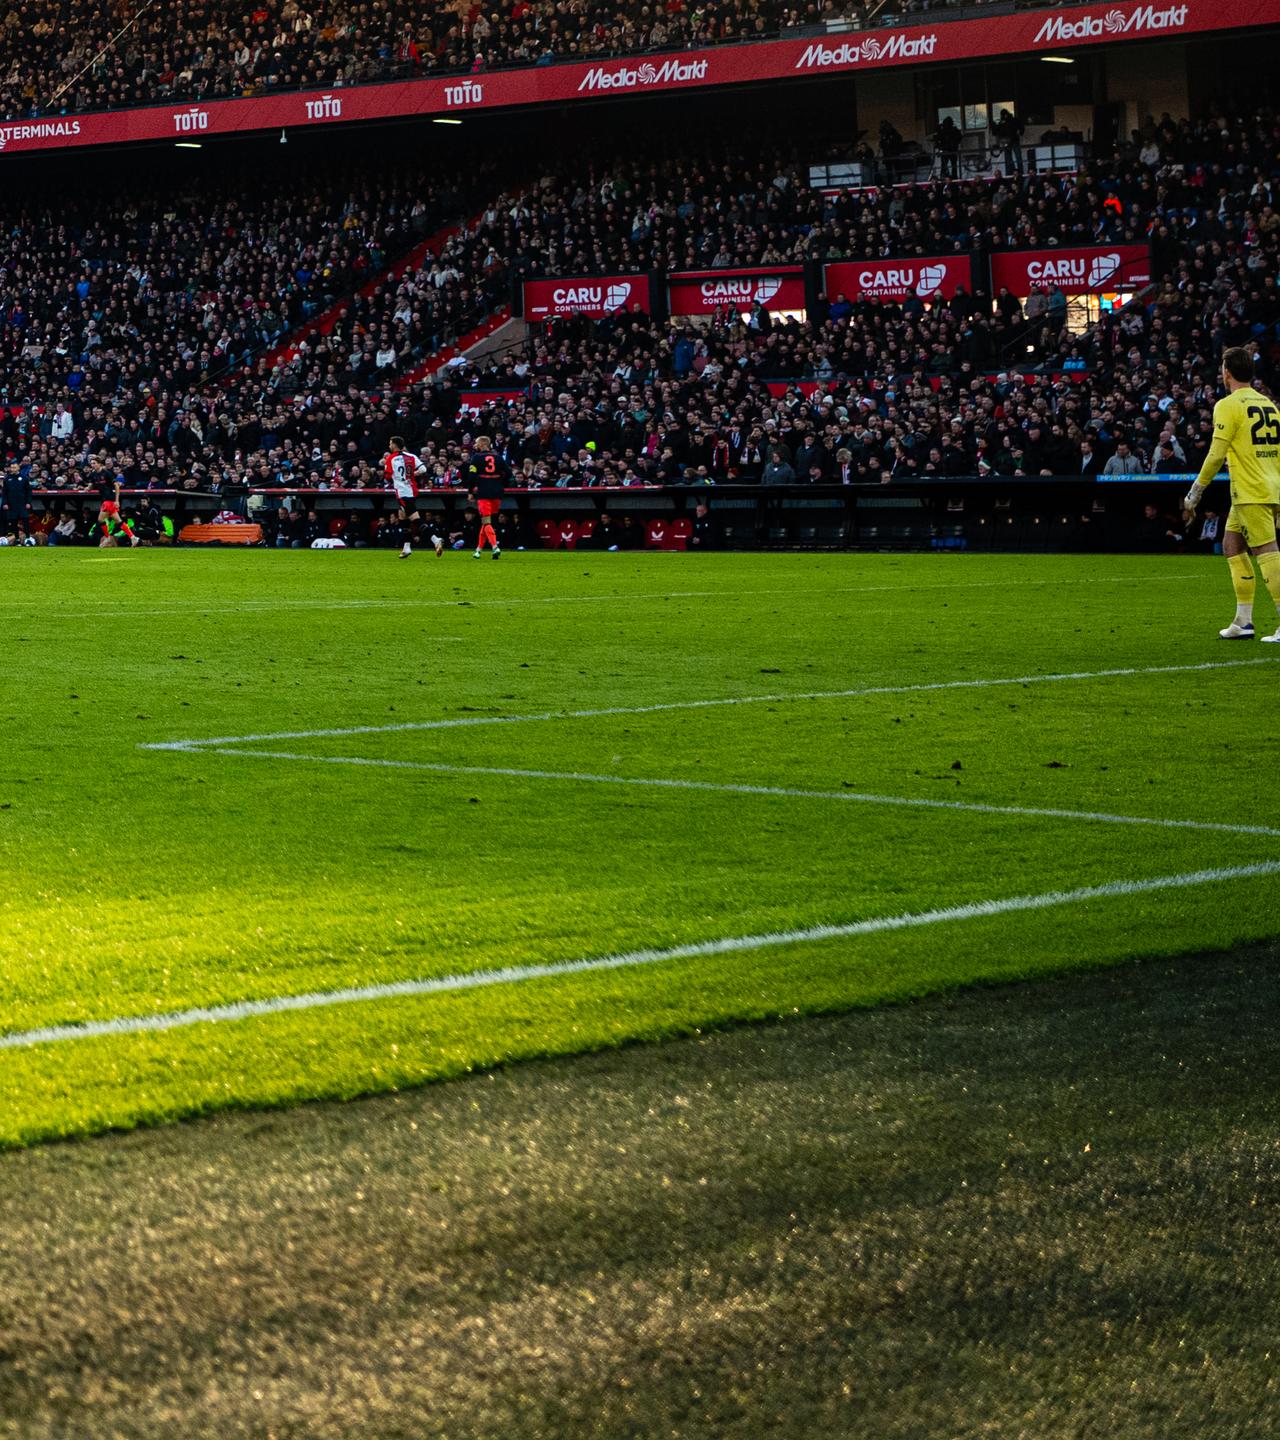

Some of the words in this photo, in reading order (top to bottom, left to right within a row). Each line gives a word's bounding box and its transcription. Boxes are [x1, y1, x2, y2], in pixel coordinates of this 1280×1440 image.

[1033, 16, 1104, 43] Media
[1124, 4, 1189, 33] Markt
[795, 43, 860, 68] Media
[880, 34, 938, 59] Markt
[578, 68, 637, 91] Media
[652, 60, 708, 83] Markt
[444, 80, 483, 105] TOTO
[305, 95, 342, 119] TOTO
[173, 108, 209, 131] TOTO
[859, 269, 913, 288] CARU
[1027, 258, 1085, 279] CARU
[701, 280, 752, 297] CARU
[862, 287, 907, 297] CONTAINER
[1029, 277, 1085, 287] CONTAINERS
[553, 287, 602, 304] CARU
[702, 295, 751, 305] CONTAINERS
[554, 303, 601, 312] CONTAINERS
[1247, 406, 1280, 445] 25
[485, 455, 496, 473] 3
